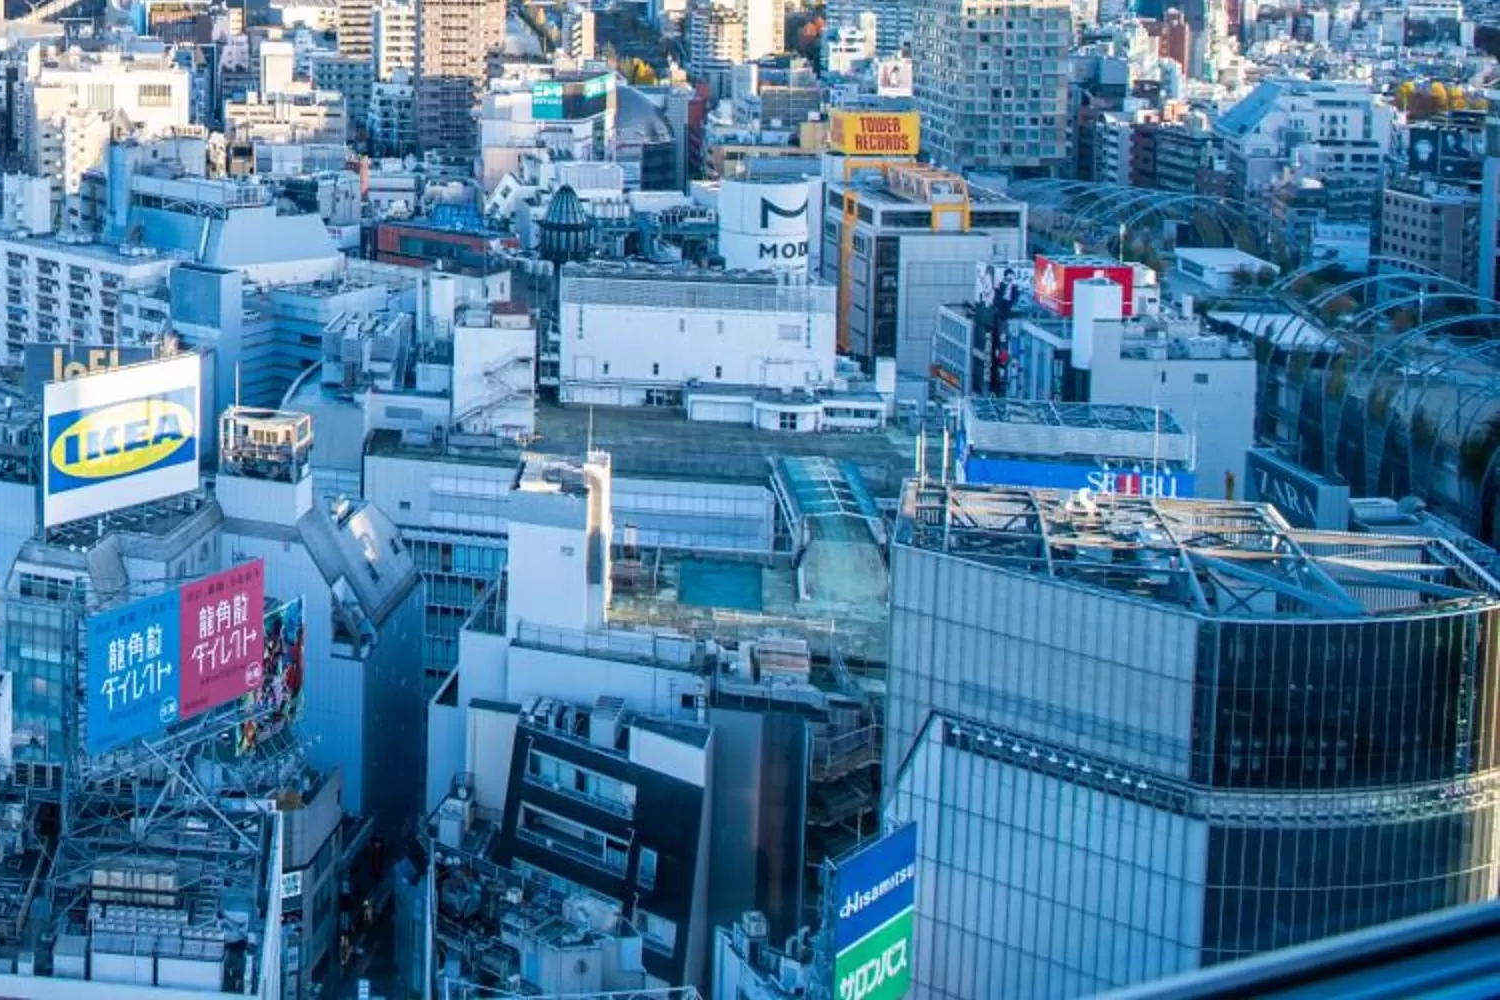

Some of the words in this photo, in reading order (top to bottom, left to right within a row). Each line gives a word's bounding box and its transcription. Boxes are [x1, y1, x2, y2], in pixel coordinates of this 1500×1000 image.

[855, 134, 909, 150] RECORDS
[860, 116, 901, 132] TOWER
[65, 412, 184, 465] IKEA
[1087, 471, 1177, 498] SEIBU
[1255, 467, 1317, 522] ZARA
[198, 592, 249, 639] 龍角散
[108, 624, 163, 673] 龍角散
[839, 863, 916, 918] Hisamitsu
